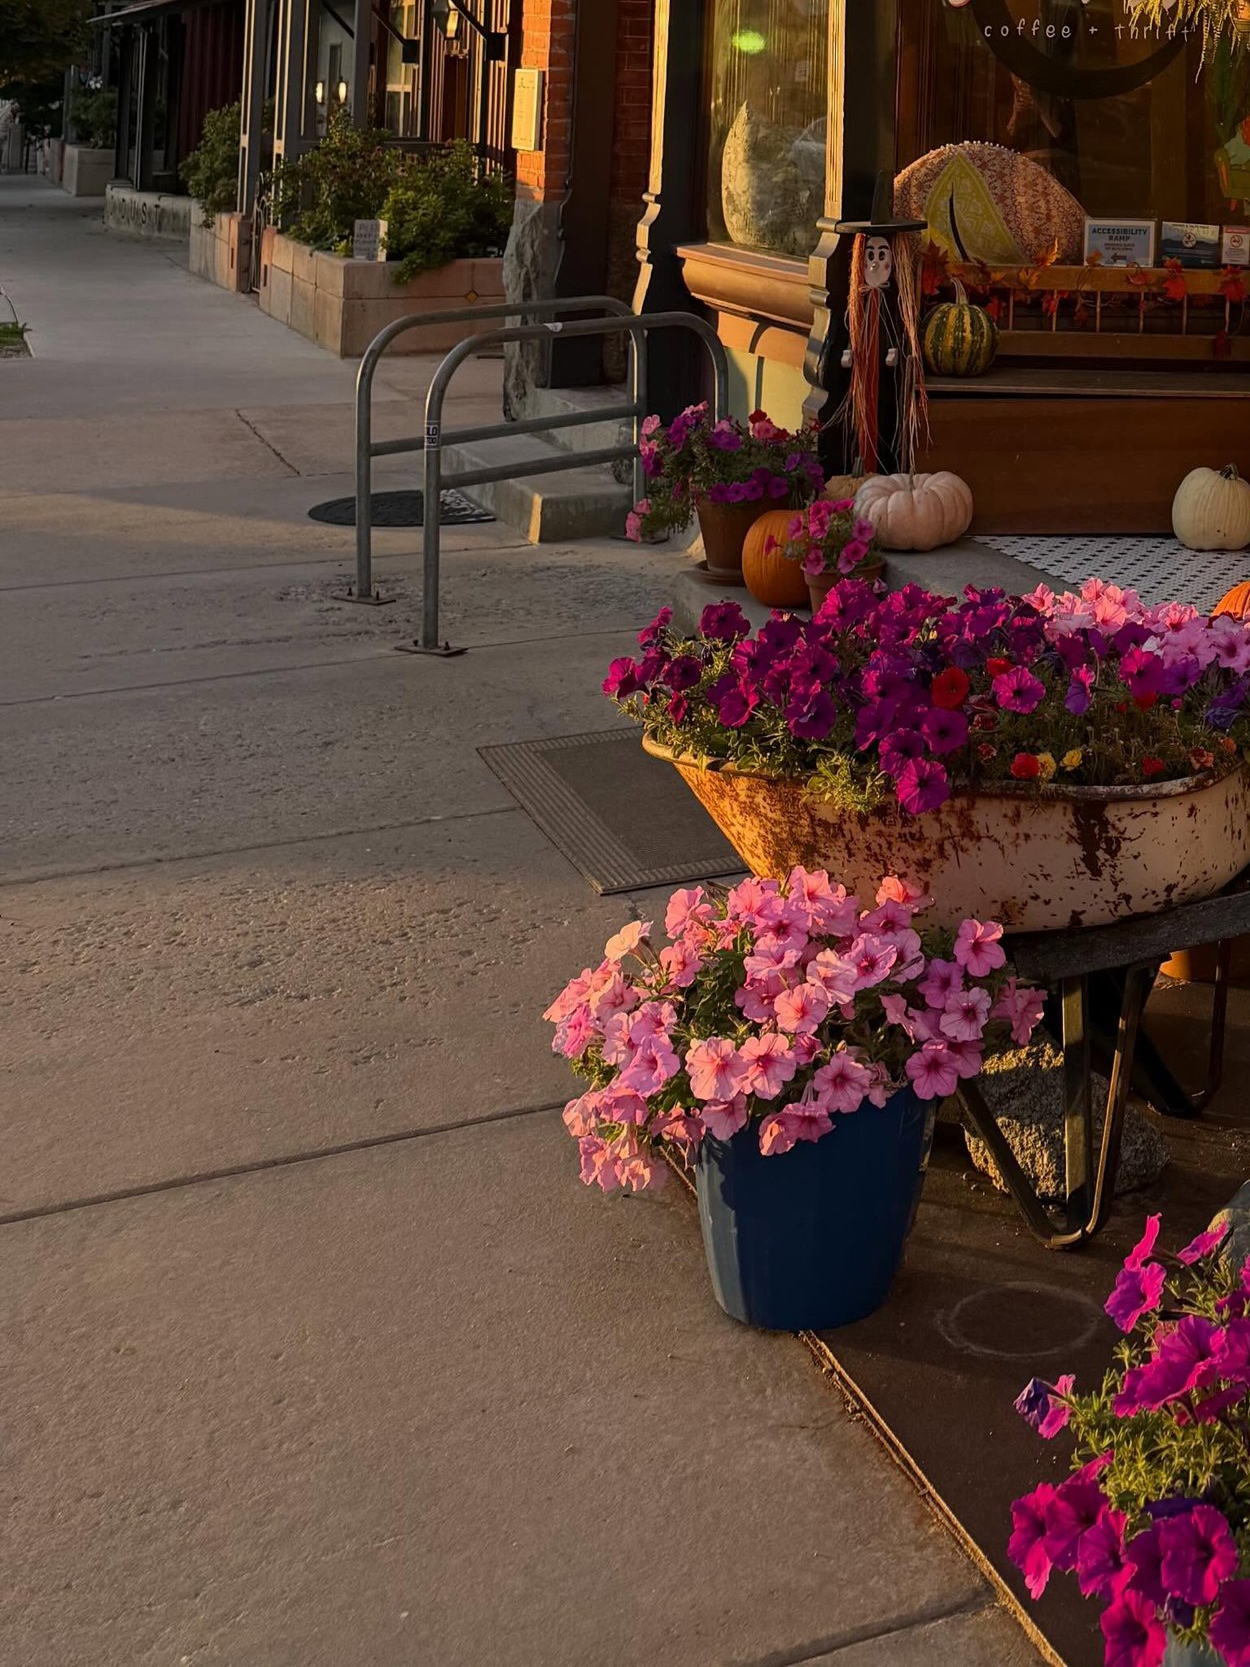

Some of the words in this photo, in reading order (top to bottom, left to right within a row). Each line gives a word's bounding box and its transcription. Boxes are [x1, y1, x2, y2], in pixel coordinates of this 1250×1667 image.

[984, 18, 1073, 39] coffee
[1114, 21, 1195, 42] thrift
[1091, 227, 1148, 236] ACCESSIBILITY
